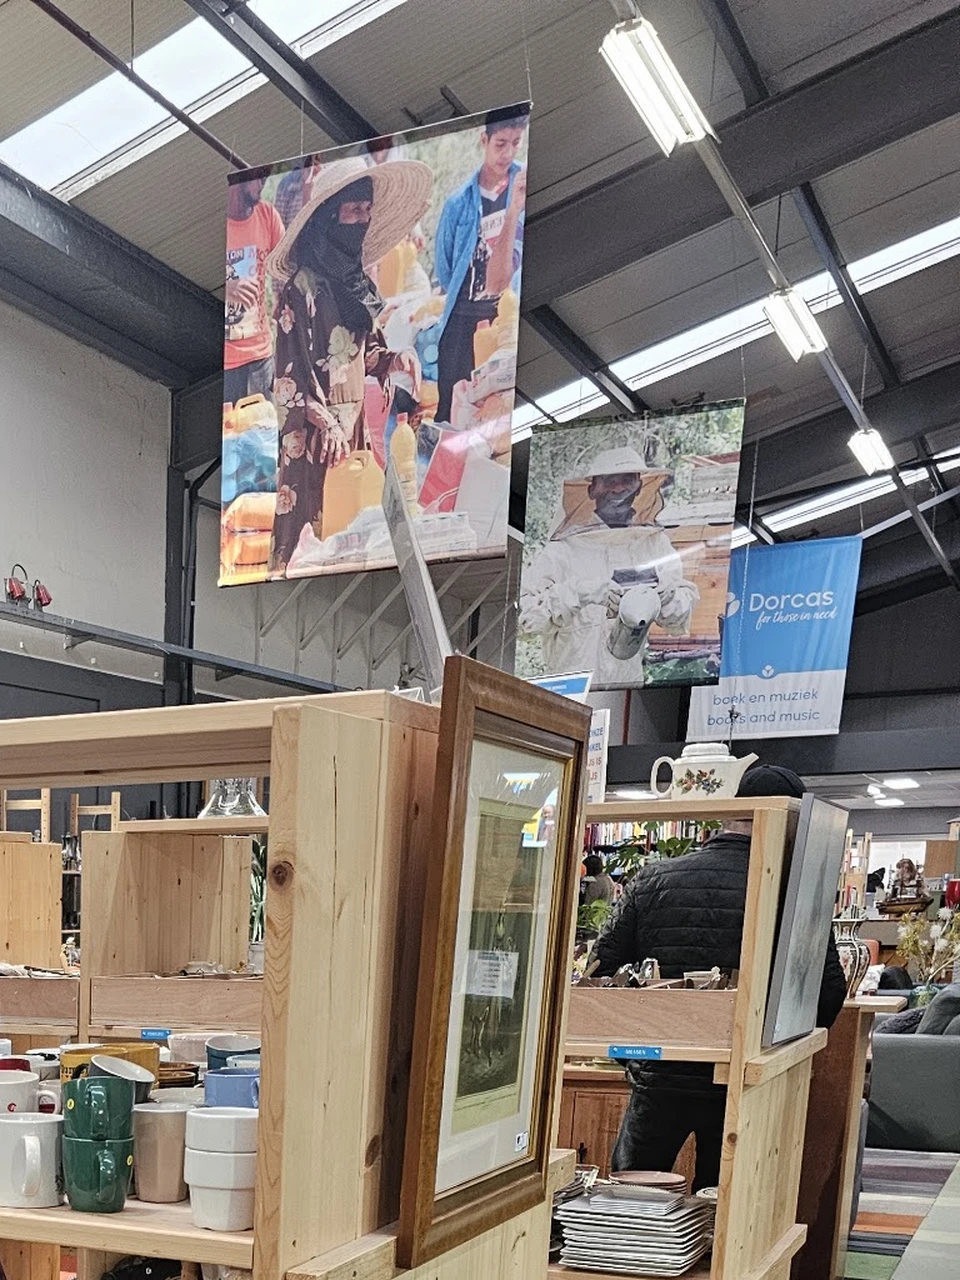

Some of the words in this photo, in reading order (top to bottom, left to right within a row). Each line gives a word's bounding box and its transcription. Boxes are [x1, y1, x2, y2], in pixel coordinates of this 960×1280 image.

[748, 591, 834, 612] Dorcas
[755, 610, 771, 631] for
[772, 610, 800, 624] those
[800, 611, 812, 622] in
[812, 606, 838, 621] need
[713, 693, 746, 706] boek
[748, 695, 766, 704] en
[769, 689, 819, 703] muziek
[749, 711, 777, 723] and
[779, 708, 820, 722] music
